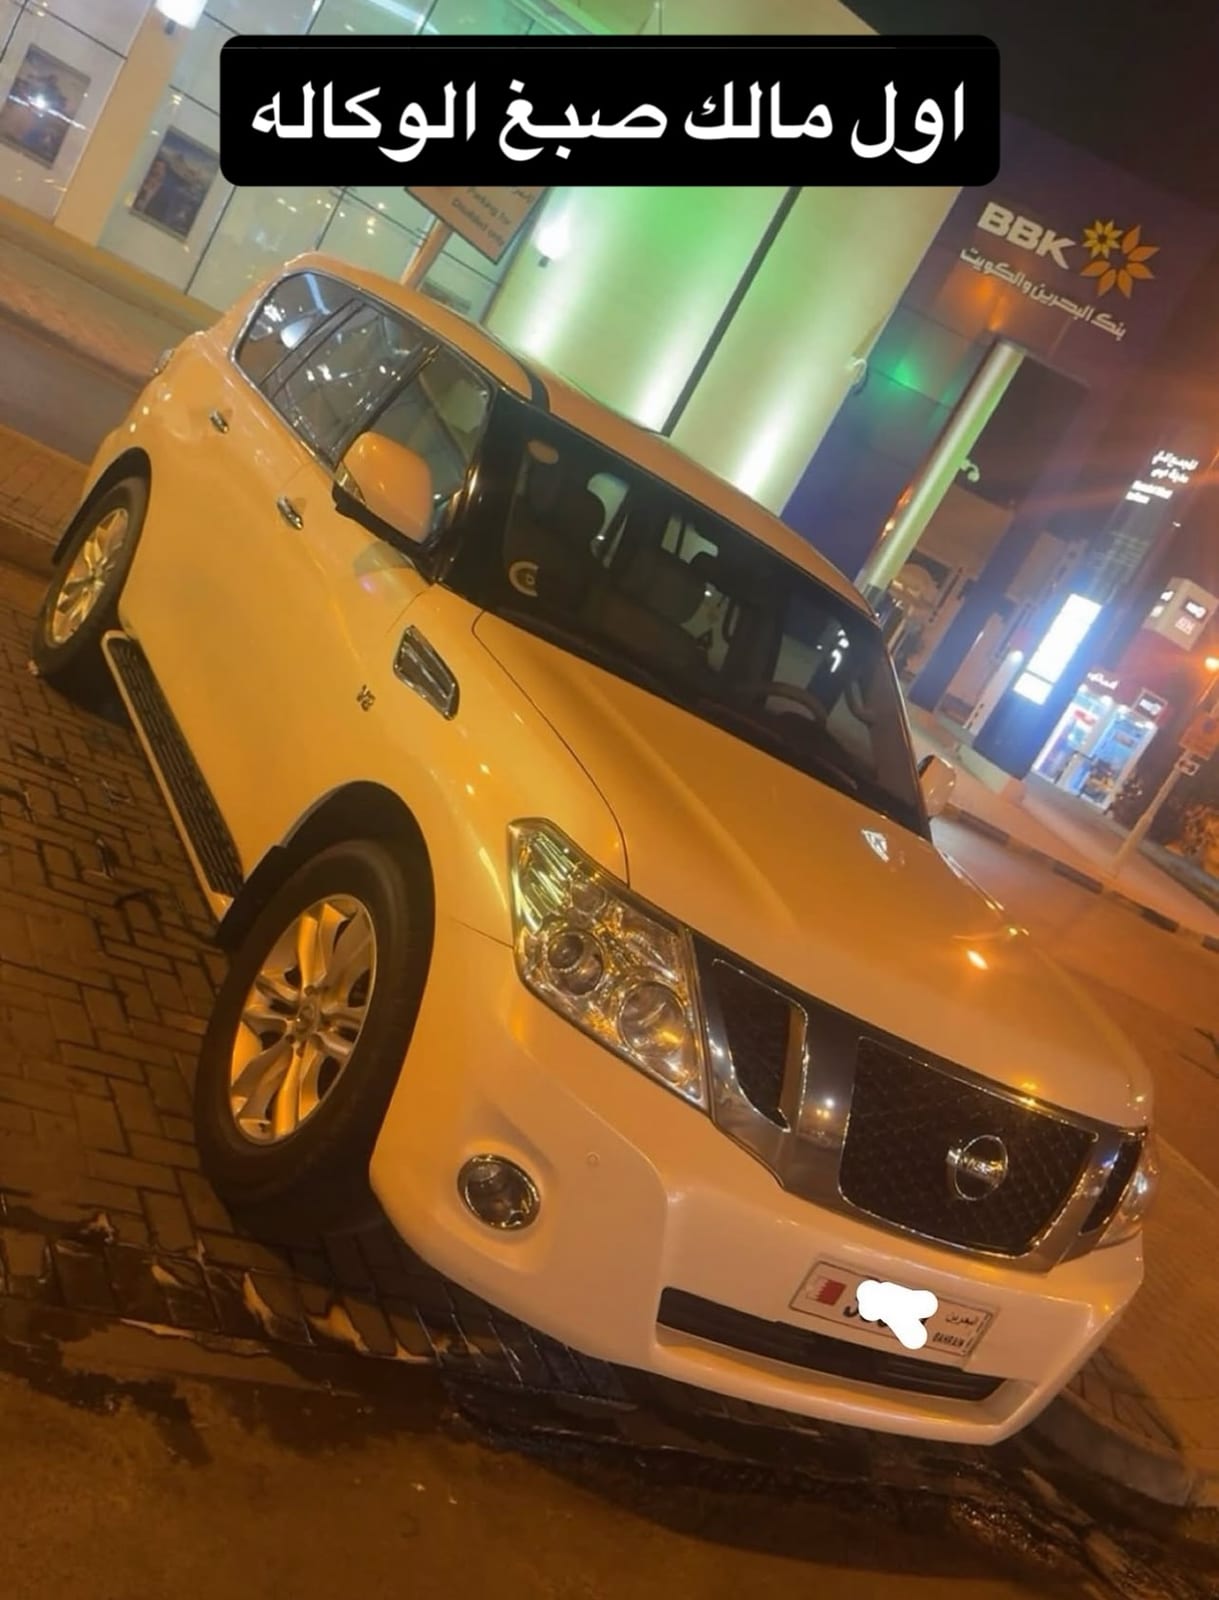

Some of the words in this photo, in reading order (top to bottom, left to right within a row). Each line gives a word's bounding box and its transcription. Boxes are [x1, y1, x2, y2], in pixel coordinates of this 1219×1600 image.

[977, 201, 1076, 270] BBK
[960, 247, 1031, 295] والكويت
[1030, 282, 1094, 321] البحرين
[1090, 313, 1126, 342] بنك
